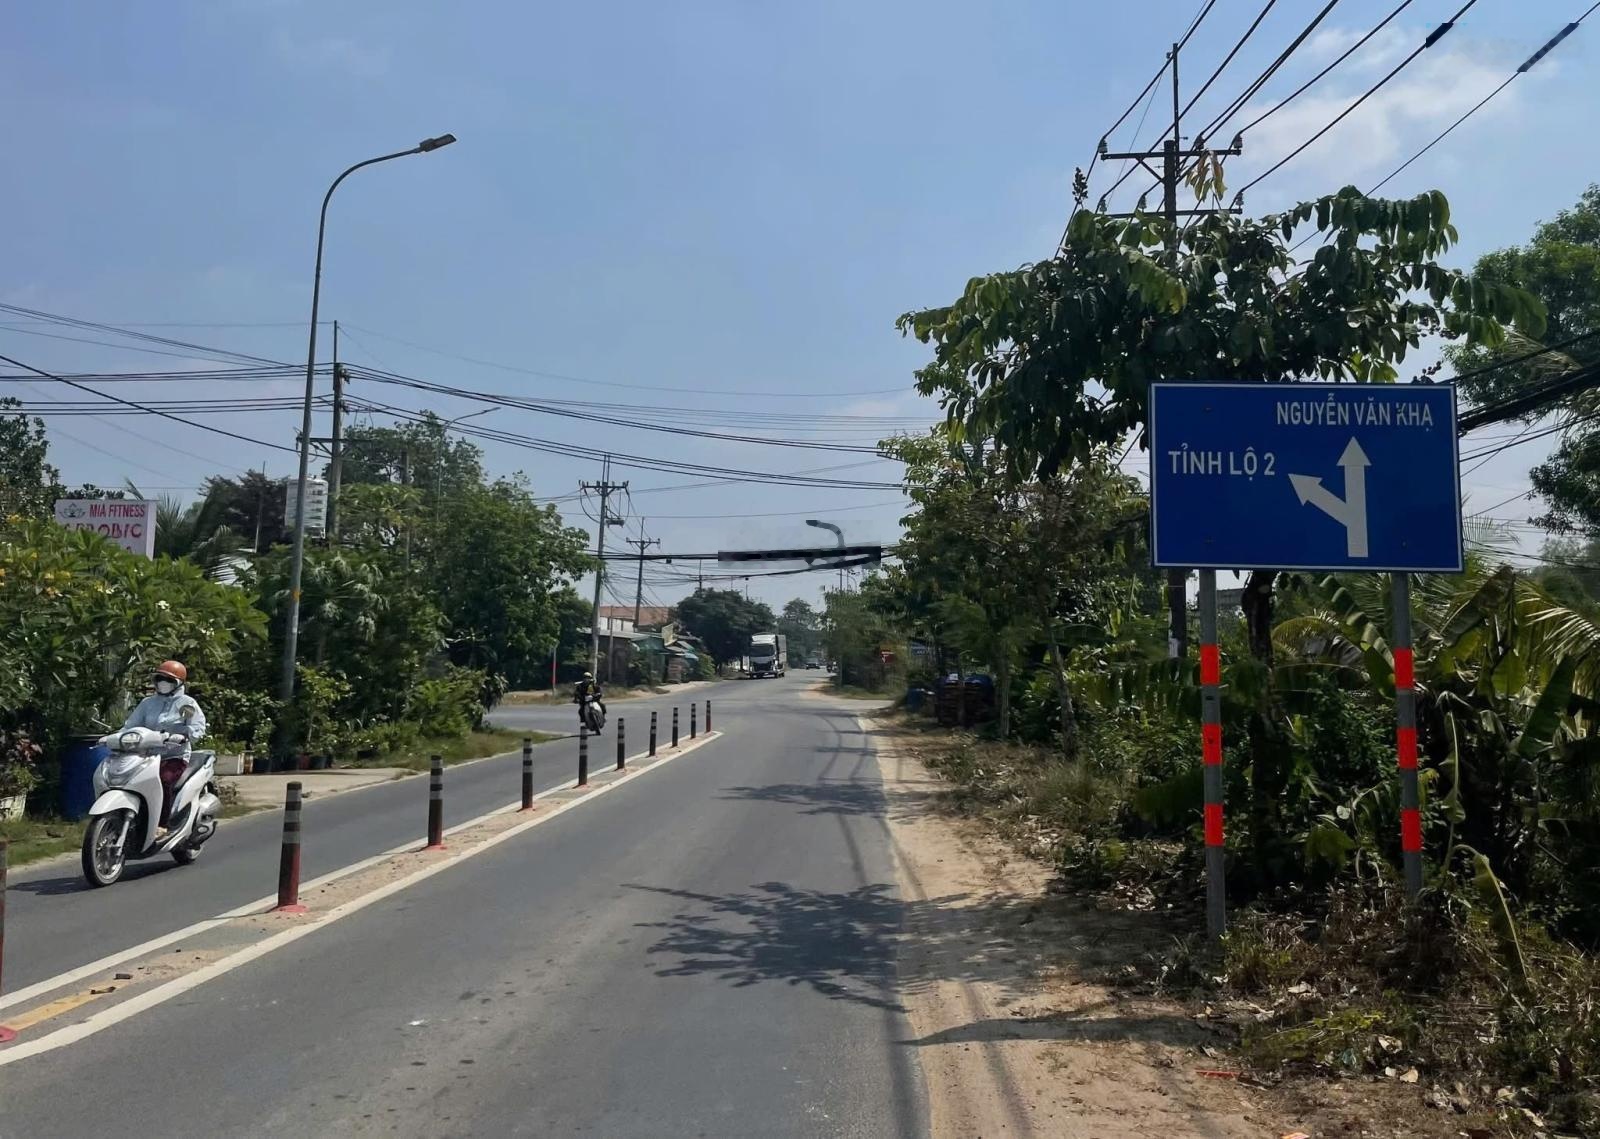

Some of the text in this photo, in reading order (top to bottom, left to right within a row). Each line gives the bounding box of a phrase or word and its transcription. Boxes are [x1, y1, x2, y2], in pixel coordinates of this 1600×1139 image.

[1276, 393, 1350, 426] NGUYỄN
[1353, 397, 1391, 426] VĂN
[1168, 442, 1276, 481] TỈNH LỘ 2
[89, 504, 146, 518] MIA FITNESS
